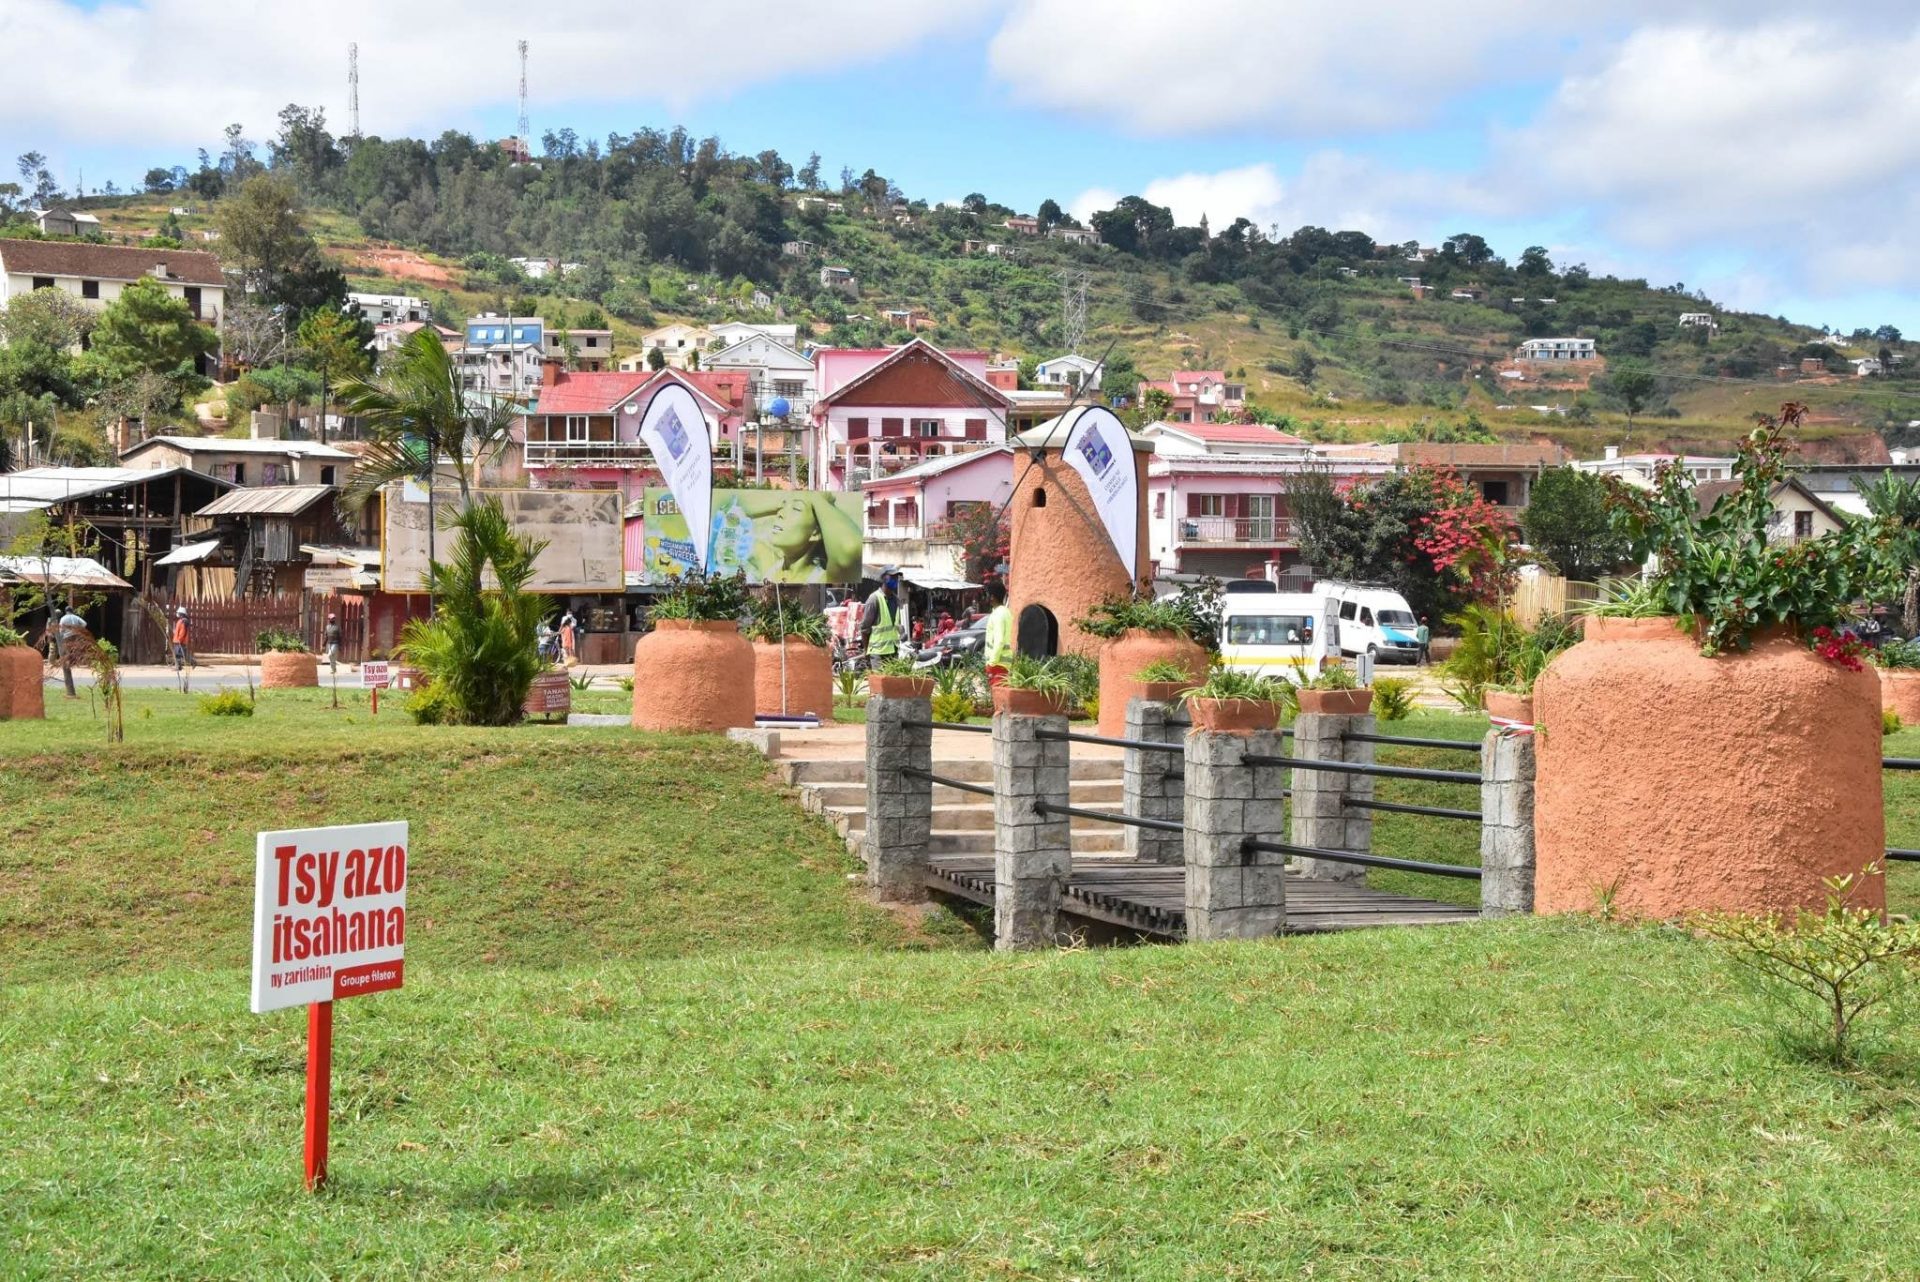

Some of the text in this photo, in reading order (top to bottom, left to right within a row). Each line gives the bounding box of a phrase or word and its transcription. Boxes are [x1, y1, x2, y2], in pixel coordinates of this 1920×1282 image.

[274, 845, 406, 908] Tsy azo
[272, 906, 405, 964] itsahana
[271, 973, 283, 988] ny
[340, 974, 370, 988] Groupe
